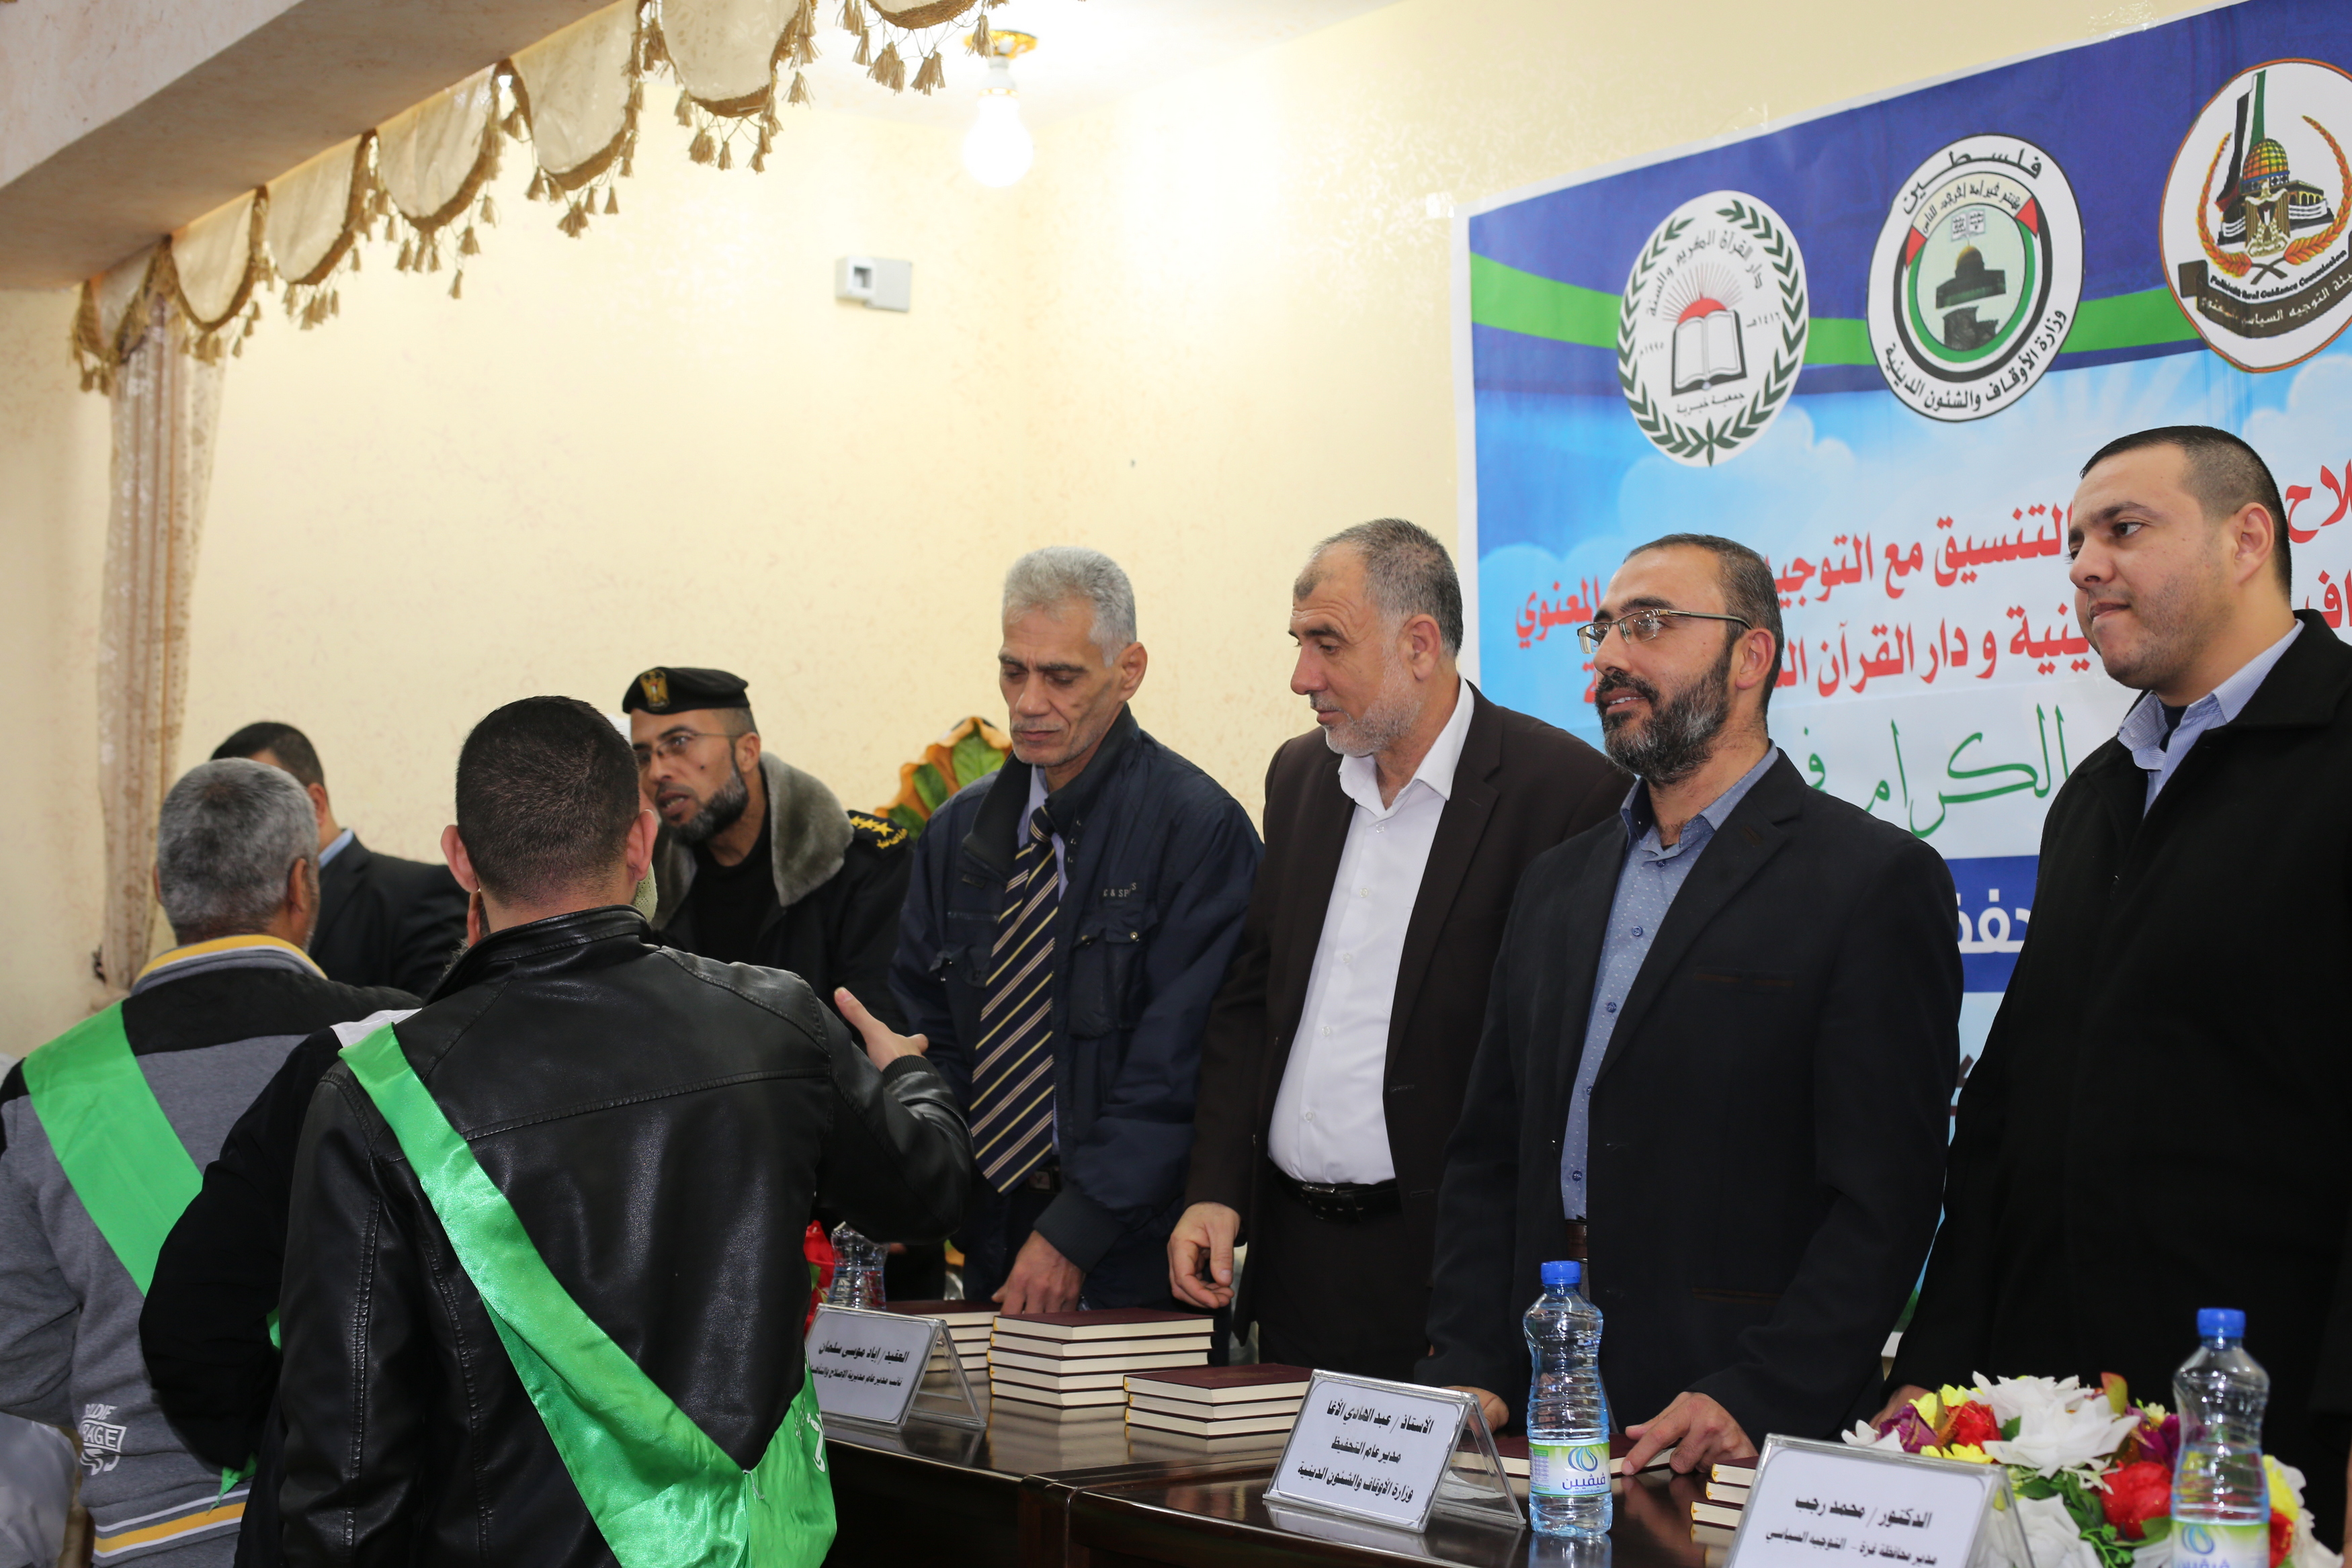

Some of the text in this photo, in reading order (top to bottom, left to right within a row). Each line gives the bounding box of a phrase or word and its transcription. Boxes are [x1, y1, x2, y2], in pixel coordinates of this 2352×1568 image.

[1902, 148, 2042, 215] فلسطين
[2331, 271, 2352, 292] يئة
[2289, 287, 2330, 318] التوجيه
[2241, 309, 2284, 328] السياس
[2034, 310, 2067, 352] وزارة
[1885, 342, 1926, 398] الدينية
[1985, 348, 2040, 402] الأوقاف
[1934, 499, 2074, 588] لتنسيق
[1764, 532, 1874, 609] التوجي
[1884, 539, 1924, 599] مع
[2006, 602, 2090, 674] ينية
[1817, 621, 1915, 698] القرآن
[1863, 702, 2070, 839] الكرام
[818, 1340, 843, 1355] سلمان
[841, 1347, 865, 1360] موسى
[884, 1349, 910, 1364] العقيد
[864, 1373, 875, 1385] عام
[874, 1377, 888, 1386] مدير
[1343, 1406, 1376, 1425] الهادي
[1373, 1412, 1392, 1428] عبد
[1400, 1414, 1435, 1435] الأستاذ
[1331, 1436, 1401, 1464] مدير عام التحفيظ
[1298, 1461, 1329, 1481] الدينية
[1363, 1477, 1393, 1496] الأوقاف
[1392, 1483, 1414, 1503] وزارة
[1795, 1496, 1826, 1517] رجب
[1829, 1499, 1865, 1520] محمد
[1877, 1508, 1933, 1530] الدكتور
[1766, 1528, 1809, 1544] السياسي
[1809, 1536, 1847, 1551] التوجيه
[1859, 1540, 1877, 1557] غزة
